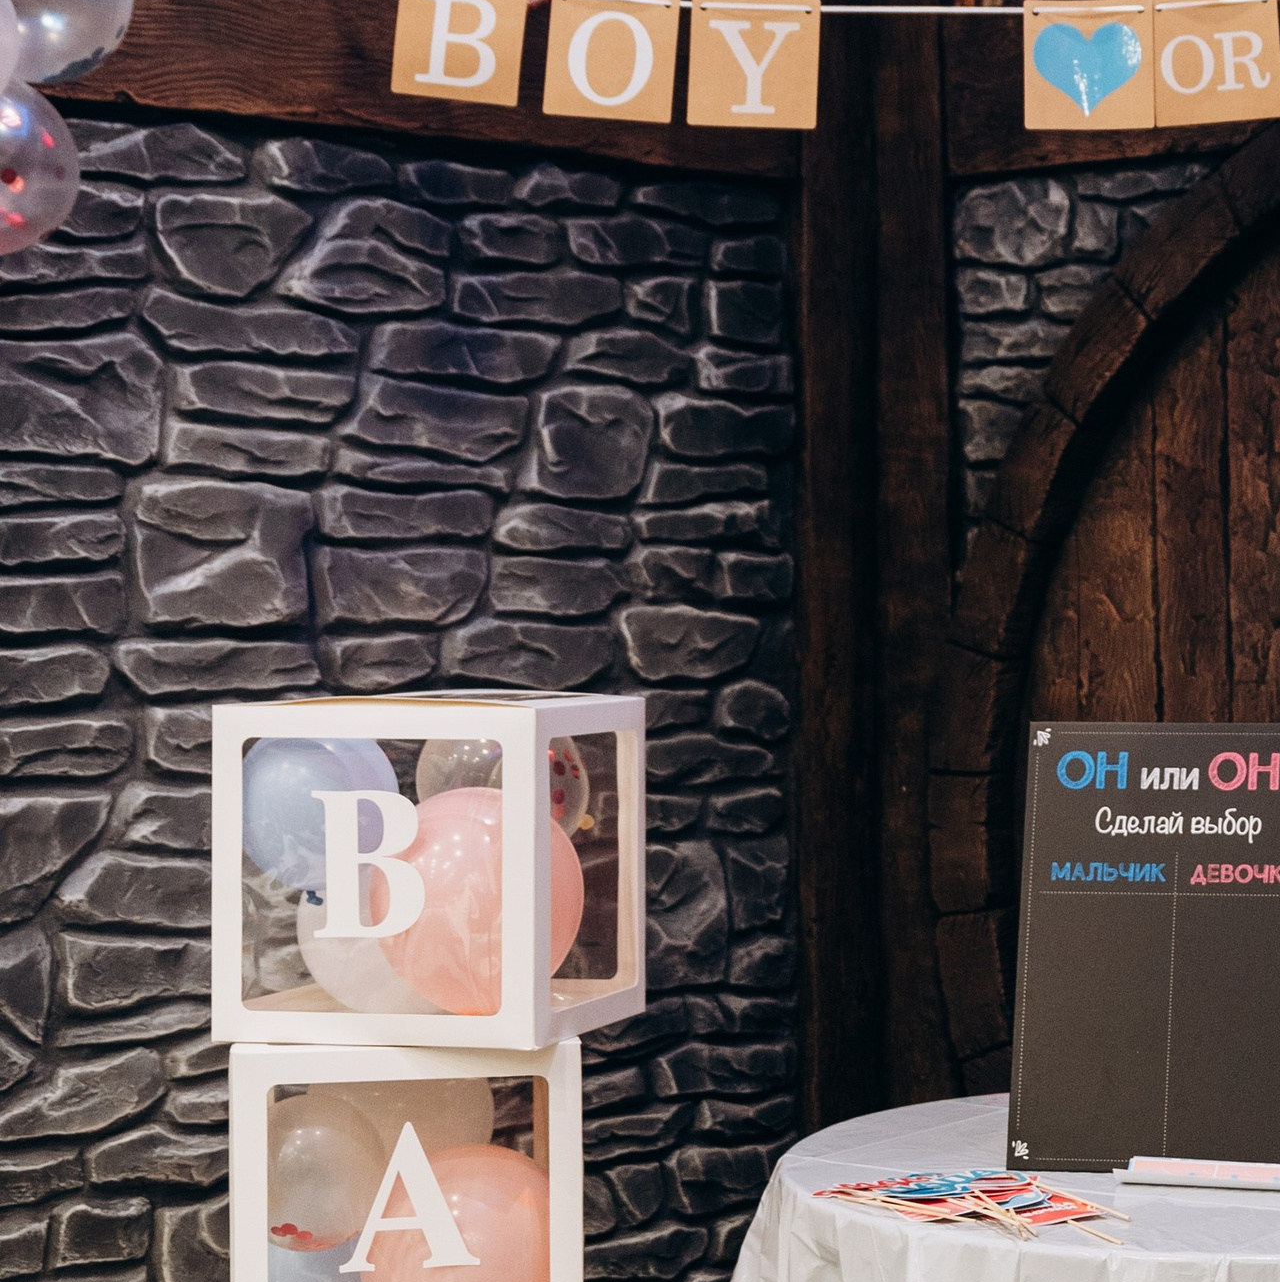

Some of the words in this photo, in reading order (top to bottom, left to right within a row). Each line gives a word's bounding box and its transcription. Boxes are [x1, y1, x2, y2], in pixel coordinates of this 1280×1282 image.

[1160, 29, 1272, 96] OR
[1056, 750, 1129, 790] ОН
[1140, 767, 1200, 790] или
[1095, 806, 1184, 836] Сделай
[1190, 807, 1263, 843] выбор
[1050, 861, 1167, 882] МАЛЬЧИК
